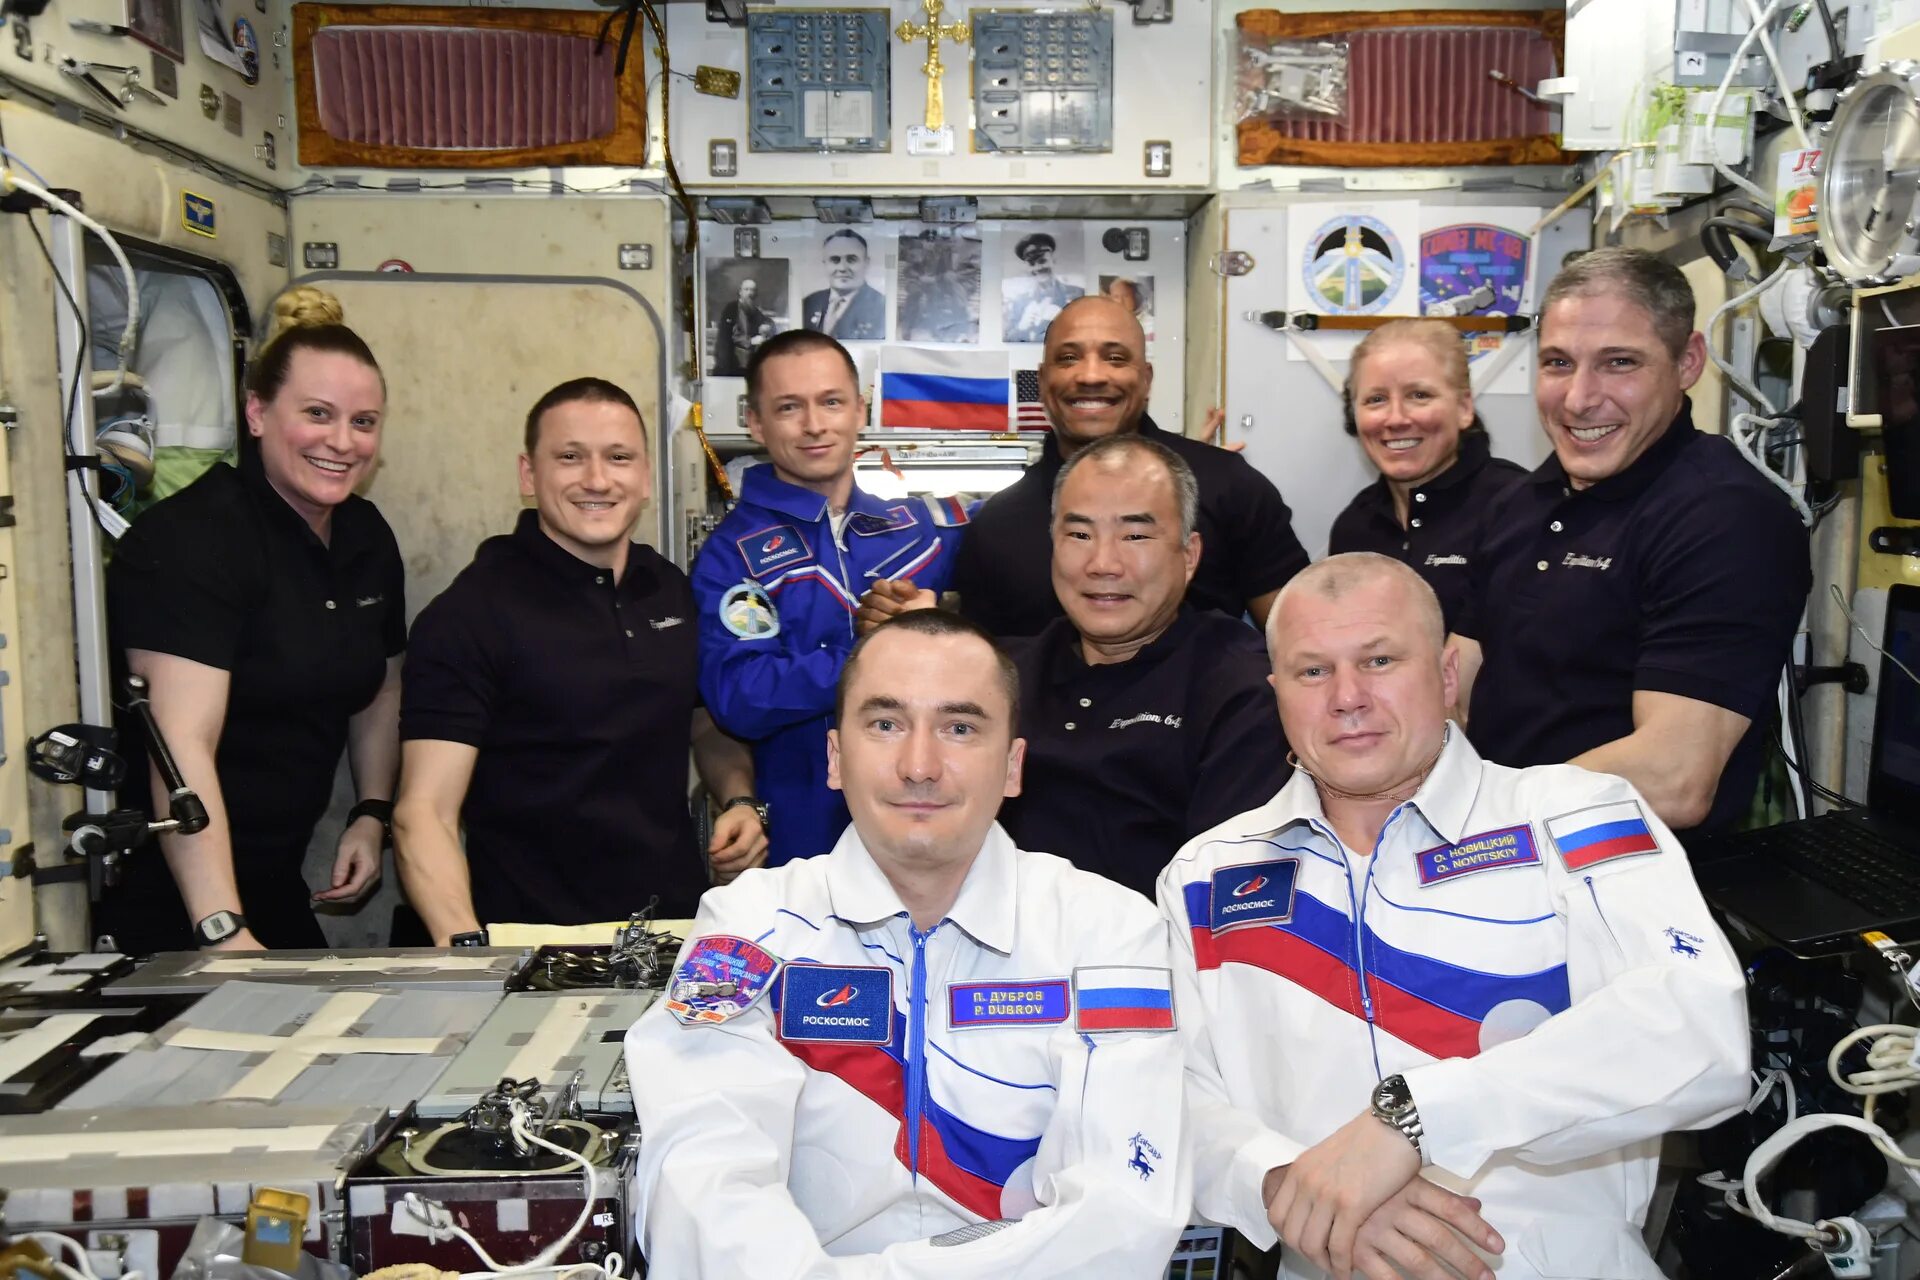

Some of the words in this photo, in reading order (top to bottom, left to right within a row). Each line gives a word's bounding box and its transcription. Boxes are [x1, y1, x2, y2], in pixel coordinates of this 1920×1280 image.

[1791, 150, 1823, 173] J7
[1163, 713, 1183, 729] 64
[1448, 834, 1517, 858] НОВИЦКИЙ
[1452, 848, 1518, 869] NOVITSKIY
[1221, 899, 1275, 915] РОСКОСМОС
[989, 991, 1044, 1003] ДУБРОВ
[988, 1004, 1044, 1015] DUBROV
[802, 1015, 870, 1027] РОСКОСМОС
